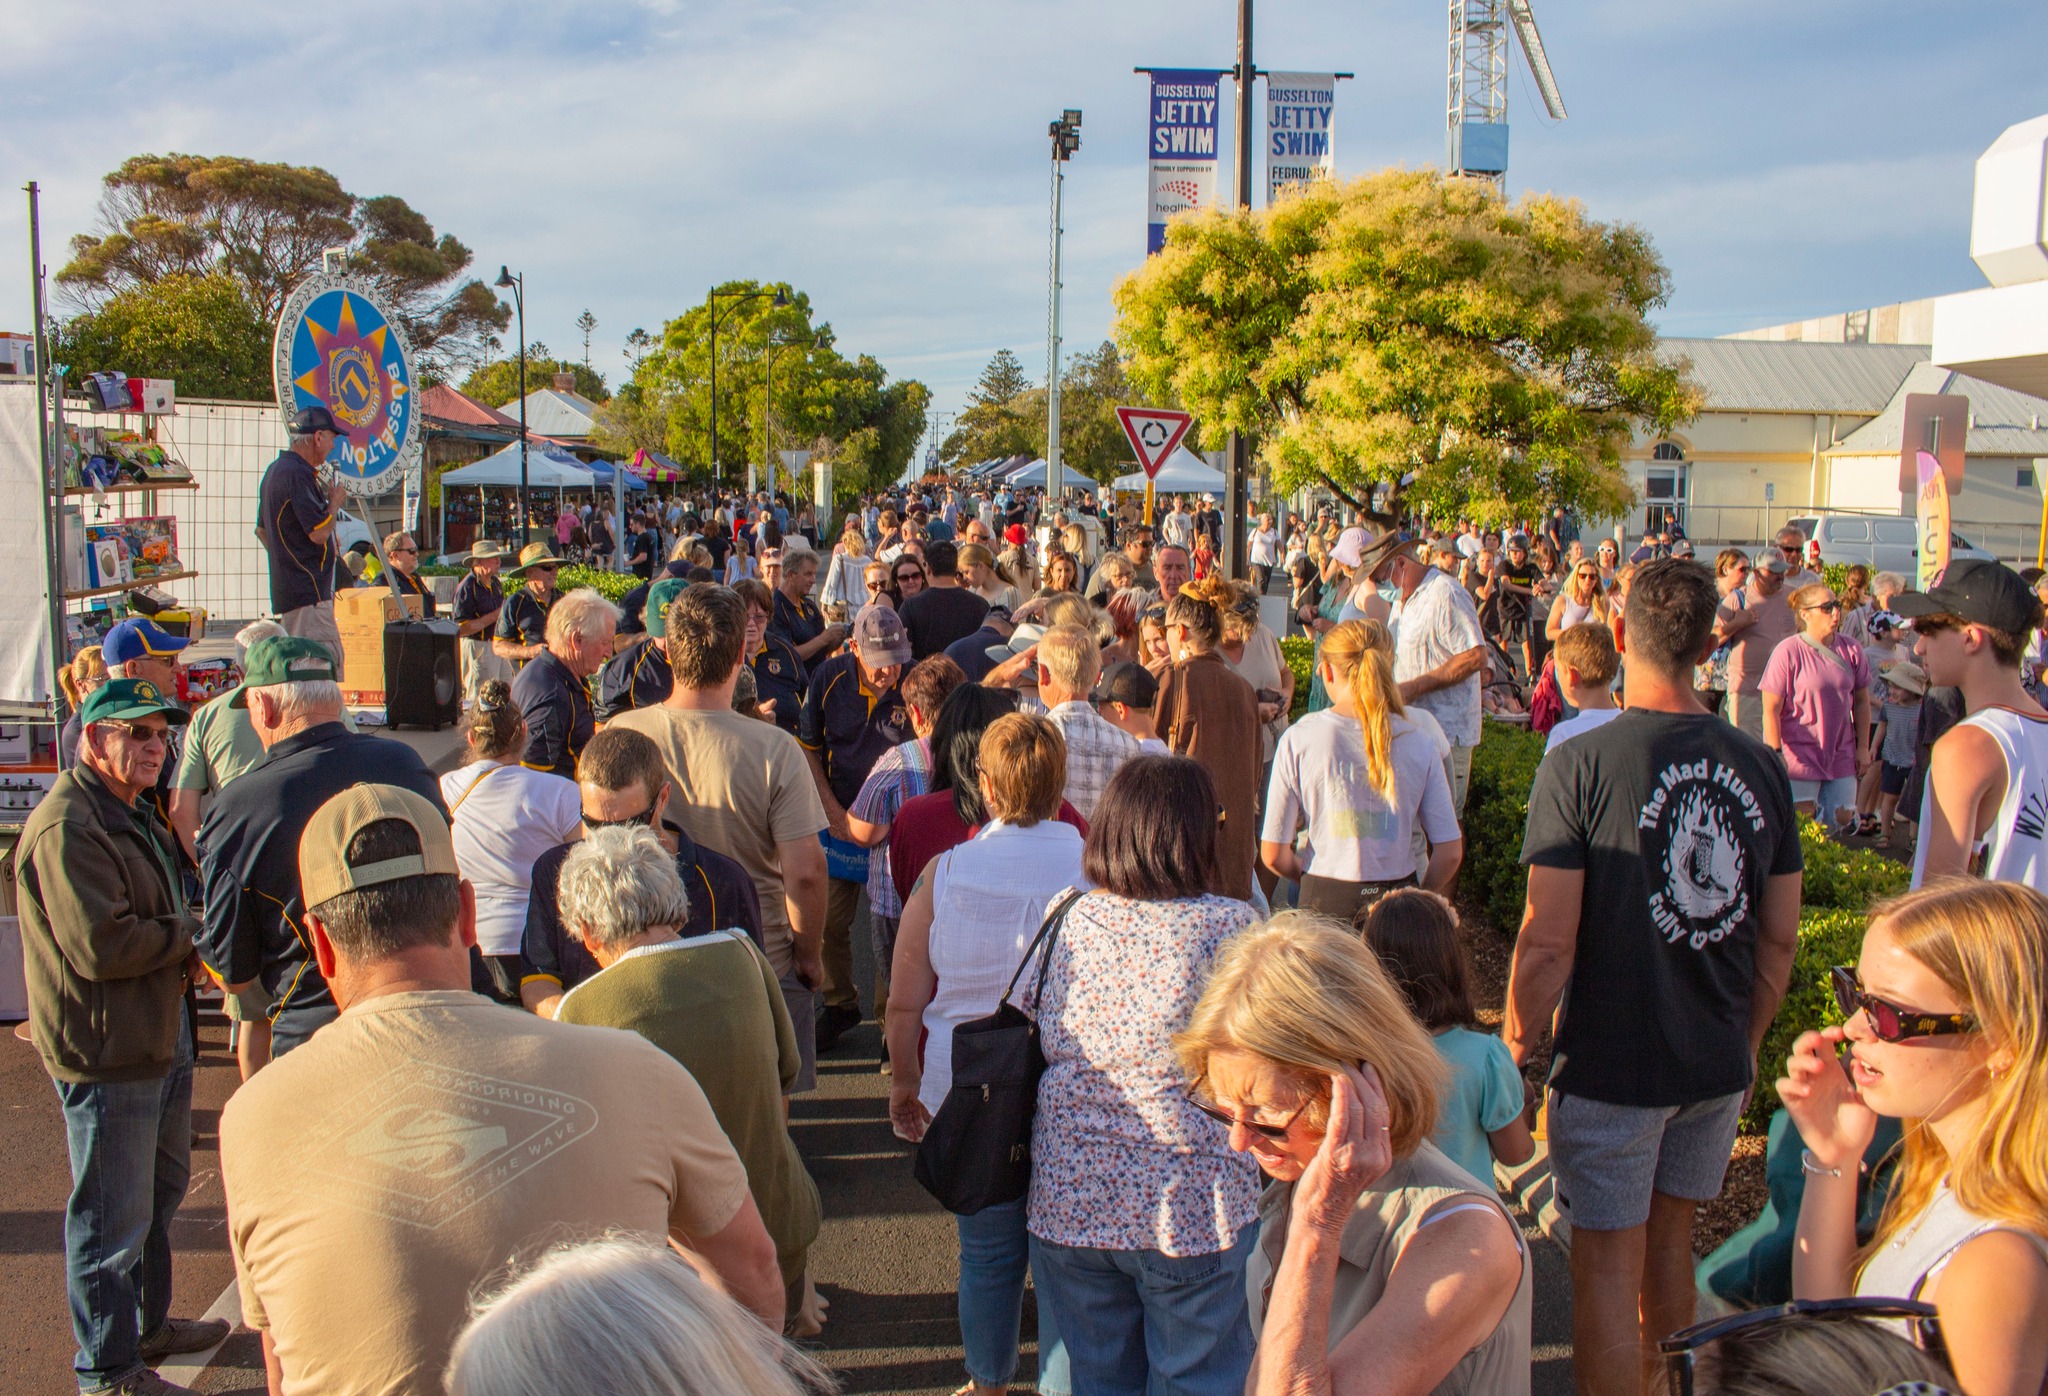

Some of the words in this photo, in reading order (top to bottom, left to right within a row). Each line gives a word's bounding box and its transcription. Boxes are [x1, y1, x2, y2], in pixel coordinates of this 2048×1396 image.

[1155, 84, 1215, 99] BUSSELTON
[1269, 88, 1333, 104] BUSSELTON
[1155, 100, 1215, 124] JETTY
[1269, 105, 1332, 129] JETTY
[1155, 127, 1214, 154] SWIM
[1272, 132, 1329, 156] SWIM
[1155, 202, 1203, 213] healthw
[313, 283, 320, 294] 5
[323, 278, 332, 290] 34
[334, 277, 342, 287] 27
[345, 278, 355, 290] 20
[358, 283, 365, 295] 13
[368, 290, 374, 301] 6
[376, 298, 386, 314] 35
[386, 310, 396, 326] 28
[410, 374, 418, 388] 36
[282, 385, 291, 397] 18
[341, 361, 403, 467] BUSSELTON
[361, 393, 380, 425] LIONS
[411, 407, 419, 422] 22
[409, 424, 417, 437] 15
[406, 438, 413, 449] 8
[392, 462, 403, 475] 30
[384, 470, 396, 484] 23
[356, 481, 362, 494] 2
[367, 480, 373, 493] 9
[376, 479, 385, 490] 16
[386, 606, 420, 622] GRCE
[1638, 787, 1667, 829] The
[1660, 758, 1708, 791] Mad
[1712, 763, 1765, 832] Hueys
[1649, 891, 1688, 944] Fully
[424, 1068, 577, 1115] BOARDRIDING
[440, 1184, 476, 1213] AND
[486, 1155, 519, 1184] THE
[528, 1121, 577, 1154] WAVE
